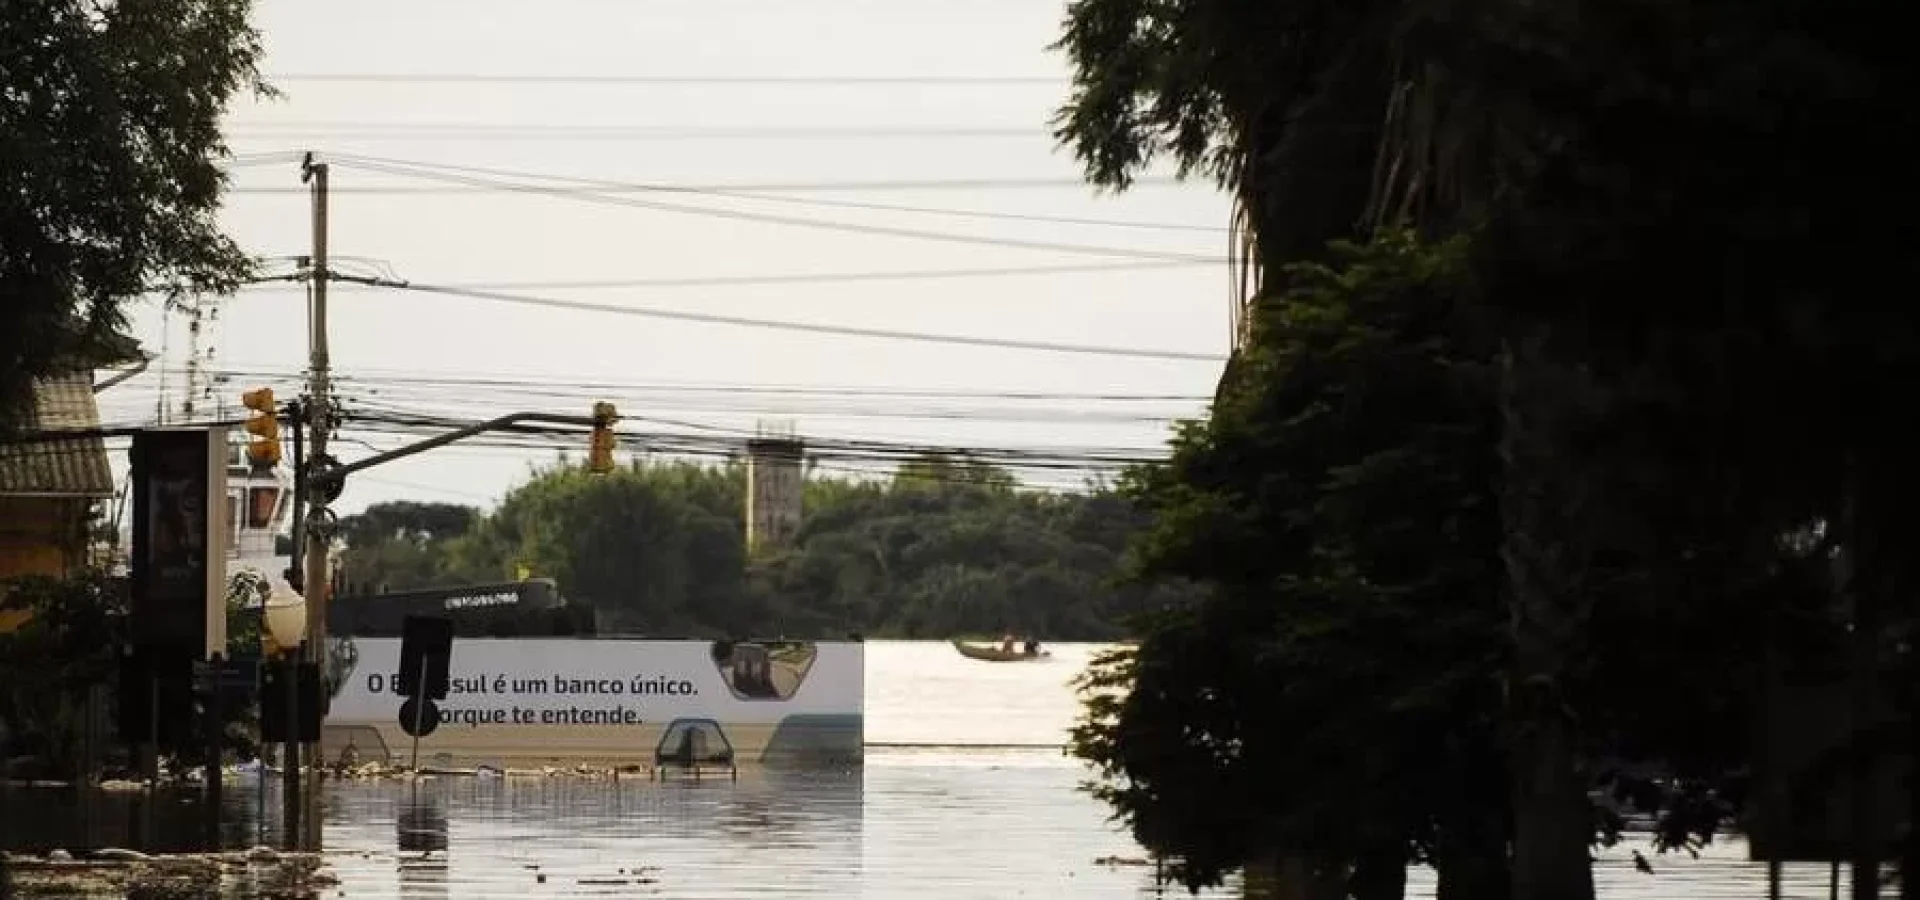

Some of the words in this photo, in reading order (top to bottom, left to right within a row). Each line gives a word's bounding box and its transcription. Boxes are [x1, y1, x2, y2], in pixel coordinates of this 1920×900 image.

[366, 673, 383, 694] O
[493, 673, 506, 694] é
[511, 679, 547, 694] um
[554, 674, 623, 695] banco
[630, 674, 699, 696] único.
[438, 709, 507, 730] orque
[511, 705, 536, 725] te
[541, 705, 643, 726] entende.
